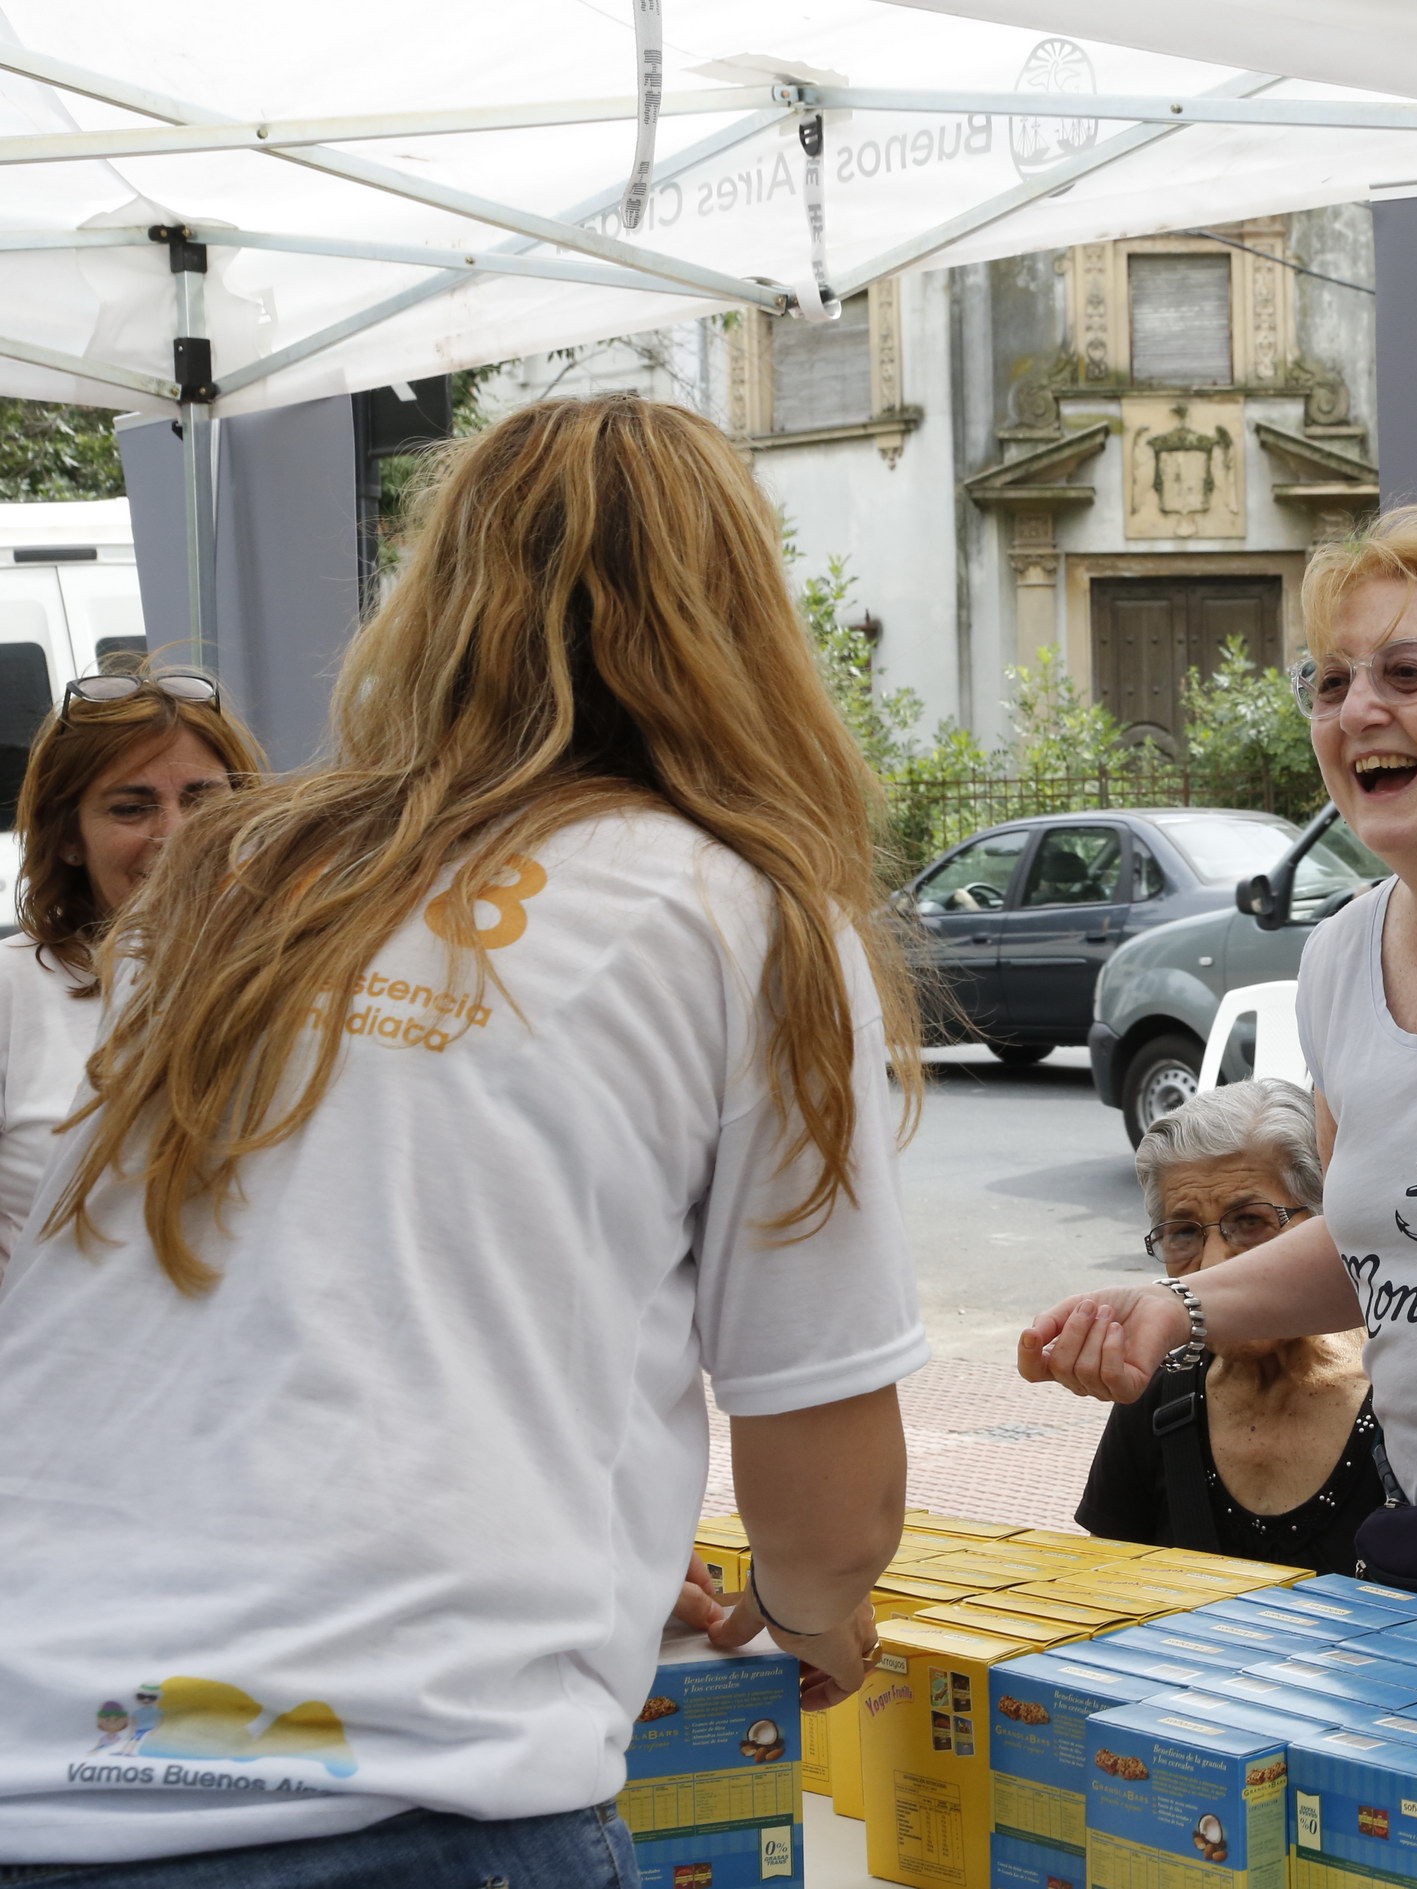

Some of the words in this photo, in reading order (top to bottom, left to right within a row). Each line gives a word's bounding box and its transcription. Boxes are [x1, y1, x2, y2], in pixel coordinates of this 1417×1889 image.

[684, 1673, 727, 1685] Beneficios
[729, 1671, 740, 1680] de
[741, 1670, 749, 1679] la
[750, 1667, 783, 1680] granola
[705, 1681, 740, 1691] cereales
[1153, 1743, 1185, 1760] Beneficios
[1185, 1752, 1194, 1761] de
[1195, 1754, 1201, 1764] la
[1201, 1759, 1227, 1771] granola
[66, 1761, 154, 1784] Vamos
[1168, 1761, 1194, 1771] cereales
[765, 1840, 788, 1856] 0%
